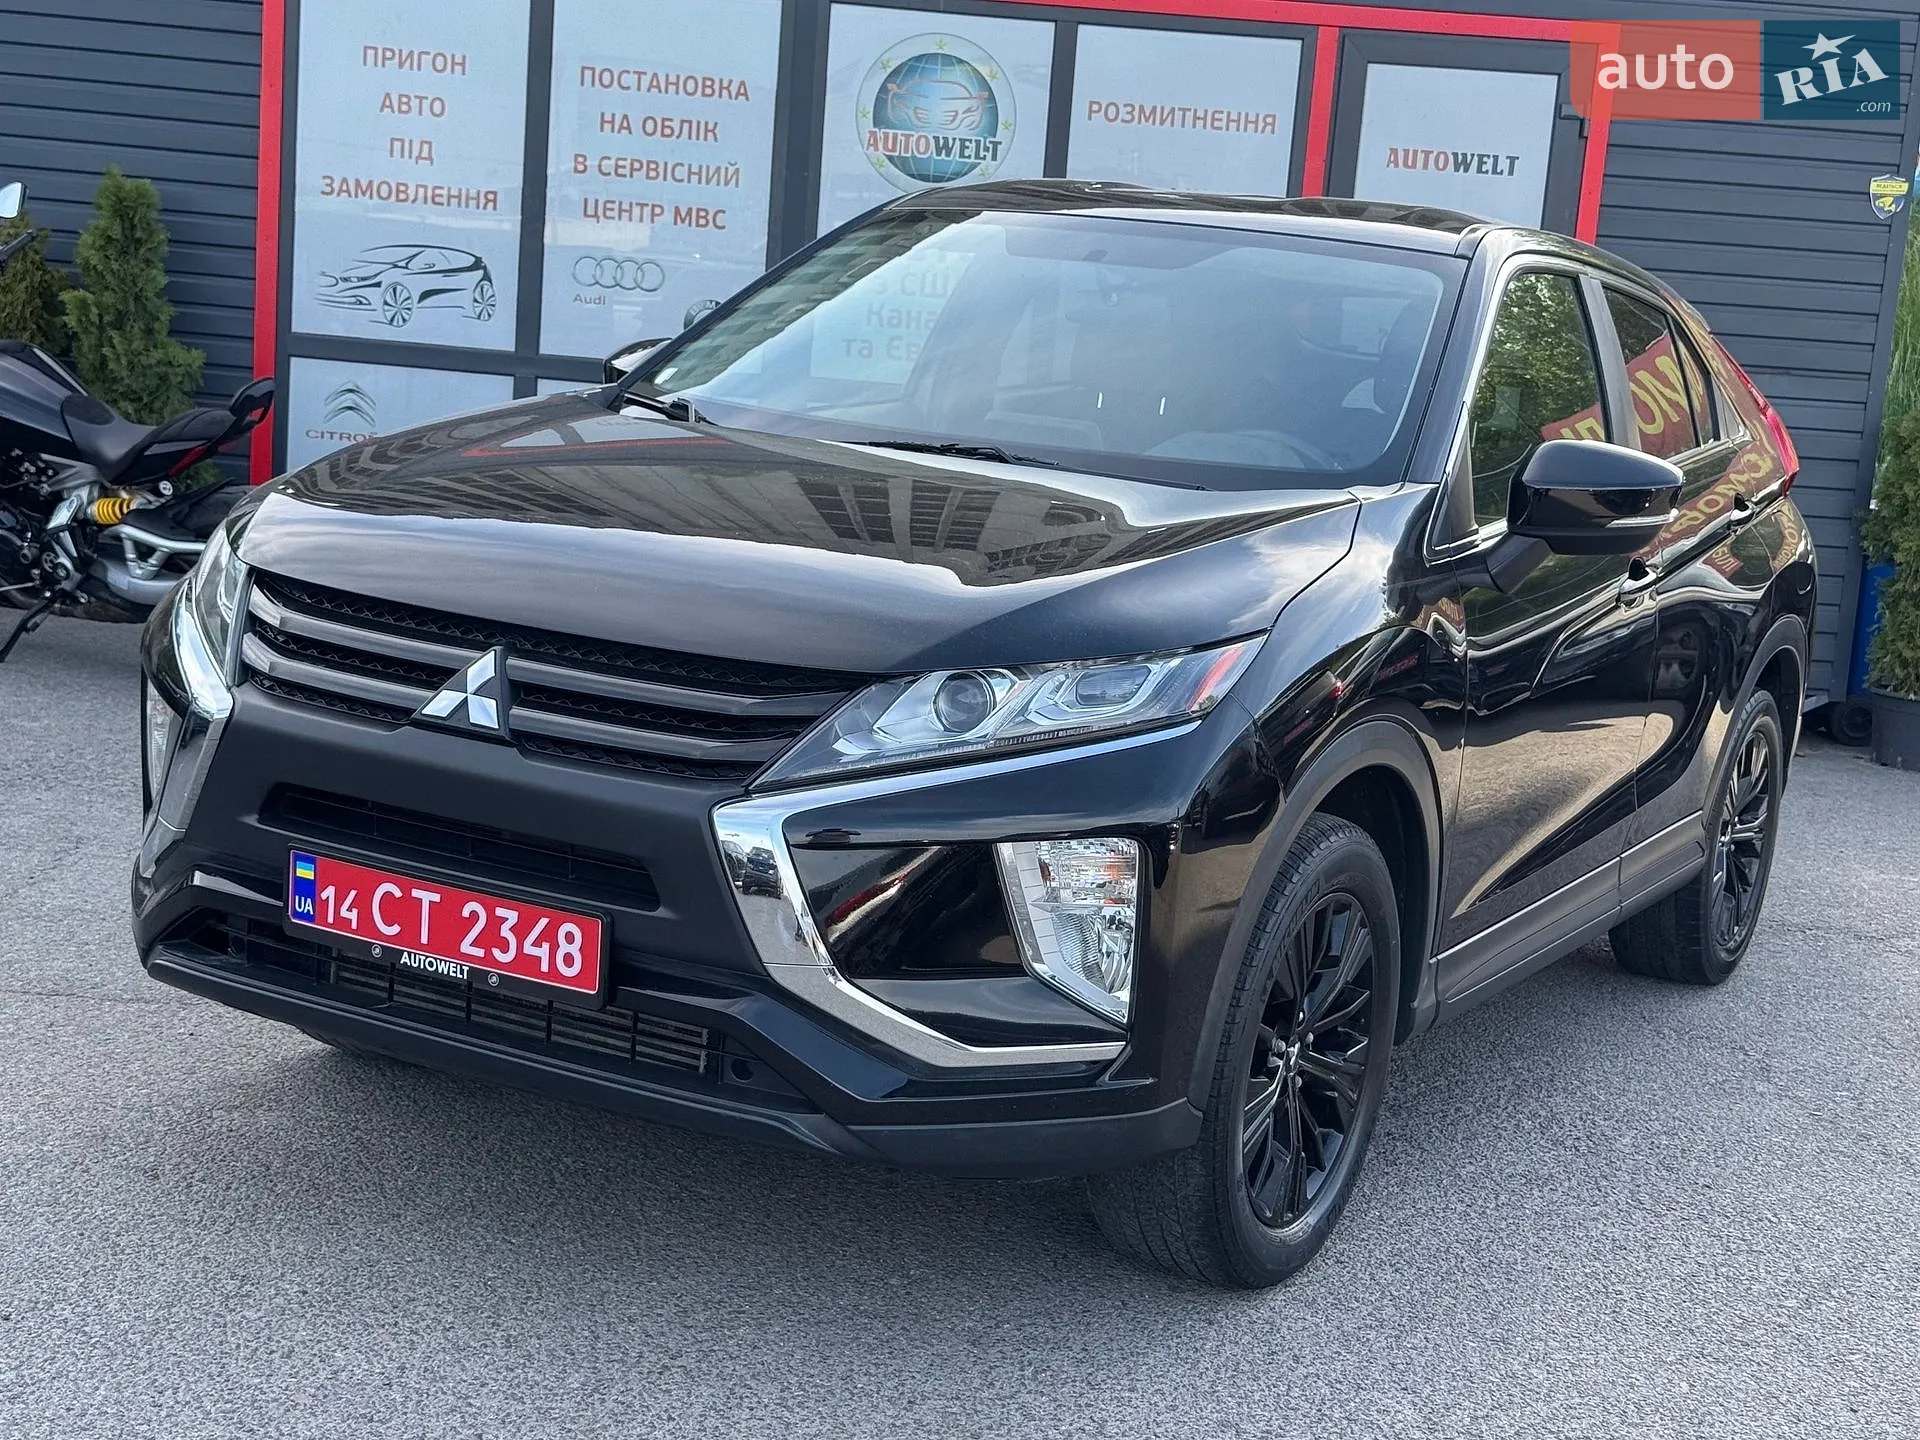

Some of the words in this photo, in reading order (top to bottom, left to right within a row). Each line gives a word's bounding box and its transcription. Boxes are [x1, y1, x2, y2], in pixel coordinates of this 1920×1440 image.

[362, 45, 467, 76] ПРИГОН
[579, 65, 750, 101] ПОСТАНОВКА
[379, 92, 446, 118] АВТО
[1087, 100, 1277, 135] РОЗМИТНЕННЯ
[599, 111, 633, 135] НА
[641, 116, 719, 143] ОБЛІК
[389, 137, 434, 167] ПІД
[866, 129, 1003, 162] AUTOWELT
[573, 153, 588, 175] В
[597, 156, 741, 188] СЕРВІСНИЙ
[1386, 147, 1520, 177] AUTOWELT
[320, 175, 499, 212] ЗАМОВЛЕННЯ
[583, 197, 665, 225] ЦЕНТР
[673, 206, 727, 231] МВС
[573, 294, 606, 306] Audi
[841, 338, 875, 360] та
[295, 896, 314, 915] UA
[320, 885, 359, 930] 14
[371, 881, 441, 945] CT
[460, 901, 583, 978] 2348
[400, 952, 470, 980] AUTOWELT
